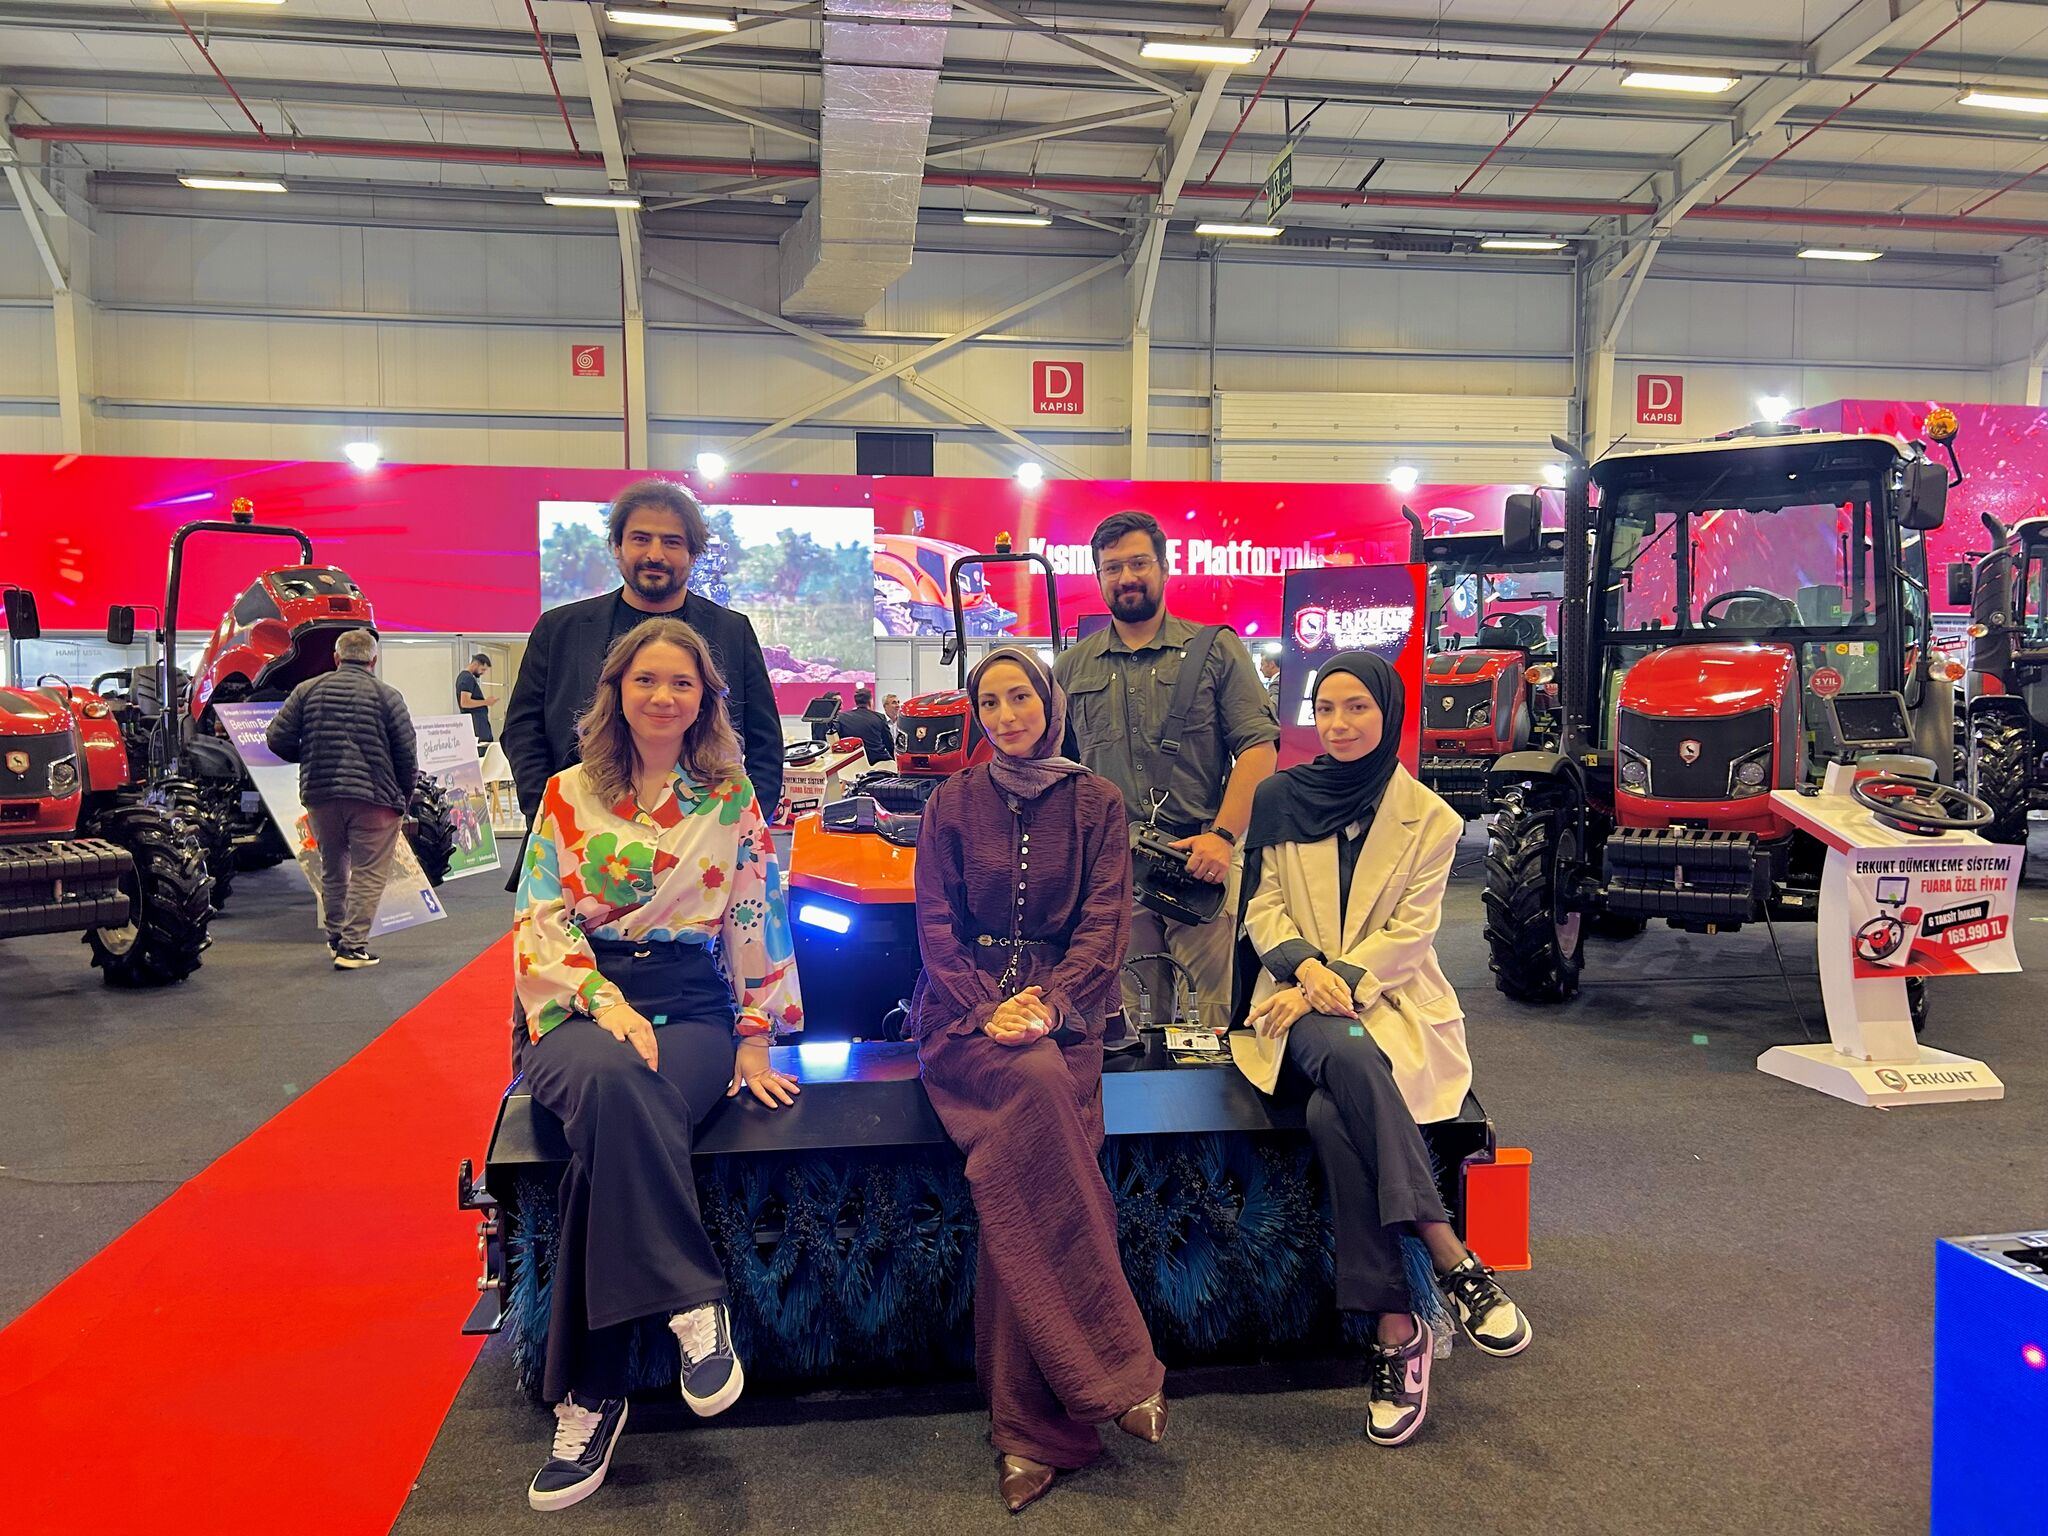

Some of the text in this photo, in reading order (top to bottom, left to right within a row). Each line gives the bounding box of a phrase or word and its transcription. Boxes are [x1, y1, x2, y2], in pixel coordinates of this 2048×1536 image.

[1045, 365, 1072, 398] D
[1648, 378, 1673, 410] D
[1040, 401, 1078, 412] KAPISI
[1642, 412, 1677, 422] KAPISI
[1028, 537, 1097, 575] Kısm
[1815, 677, 1838, 685] 3 YIL
[229, 719, 259, 730] Benim
[1856, 860, 1896, 874] ERKUNT
[1966, 855, 2012, 871] SİSTEMİ
[1921, 874, 2008, 893] FUARA ÖZEL FİYAT
[1928, 917, 1934, 927] 6
[1947, 920, 2003, 945] 169.990 TL
[1906, 1071, 1978, 1085] ERKUNT
